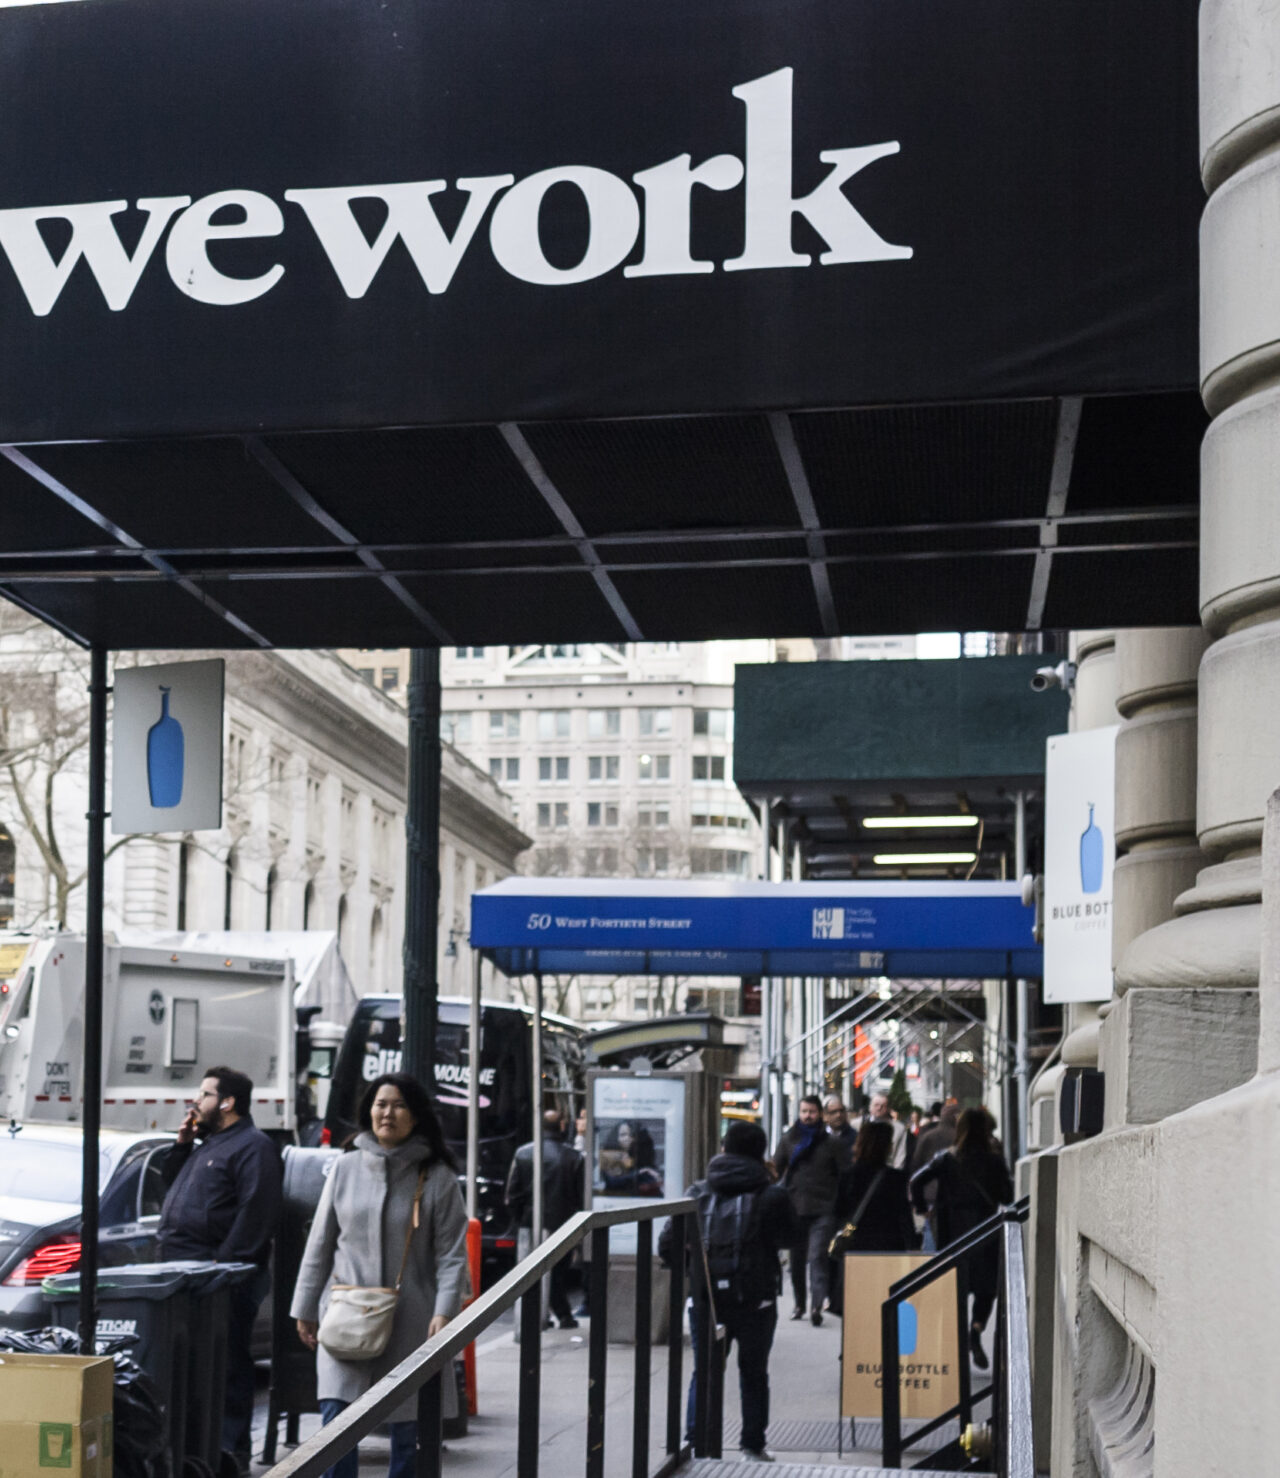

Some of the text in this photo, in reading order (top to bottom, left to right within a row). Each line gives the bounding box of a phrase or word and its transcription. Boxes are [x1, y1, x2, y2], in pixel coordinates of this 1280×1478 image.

[1052, 901, 1113, 919] BLUE BOT
[527, 913, 552, 930] 50
[362, 1050, 403, 1082] elit
[856, 1364, 883, 1375] BLU
[874, 1378, 931, 1390] CFEE
